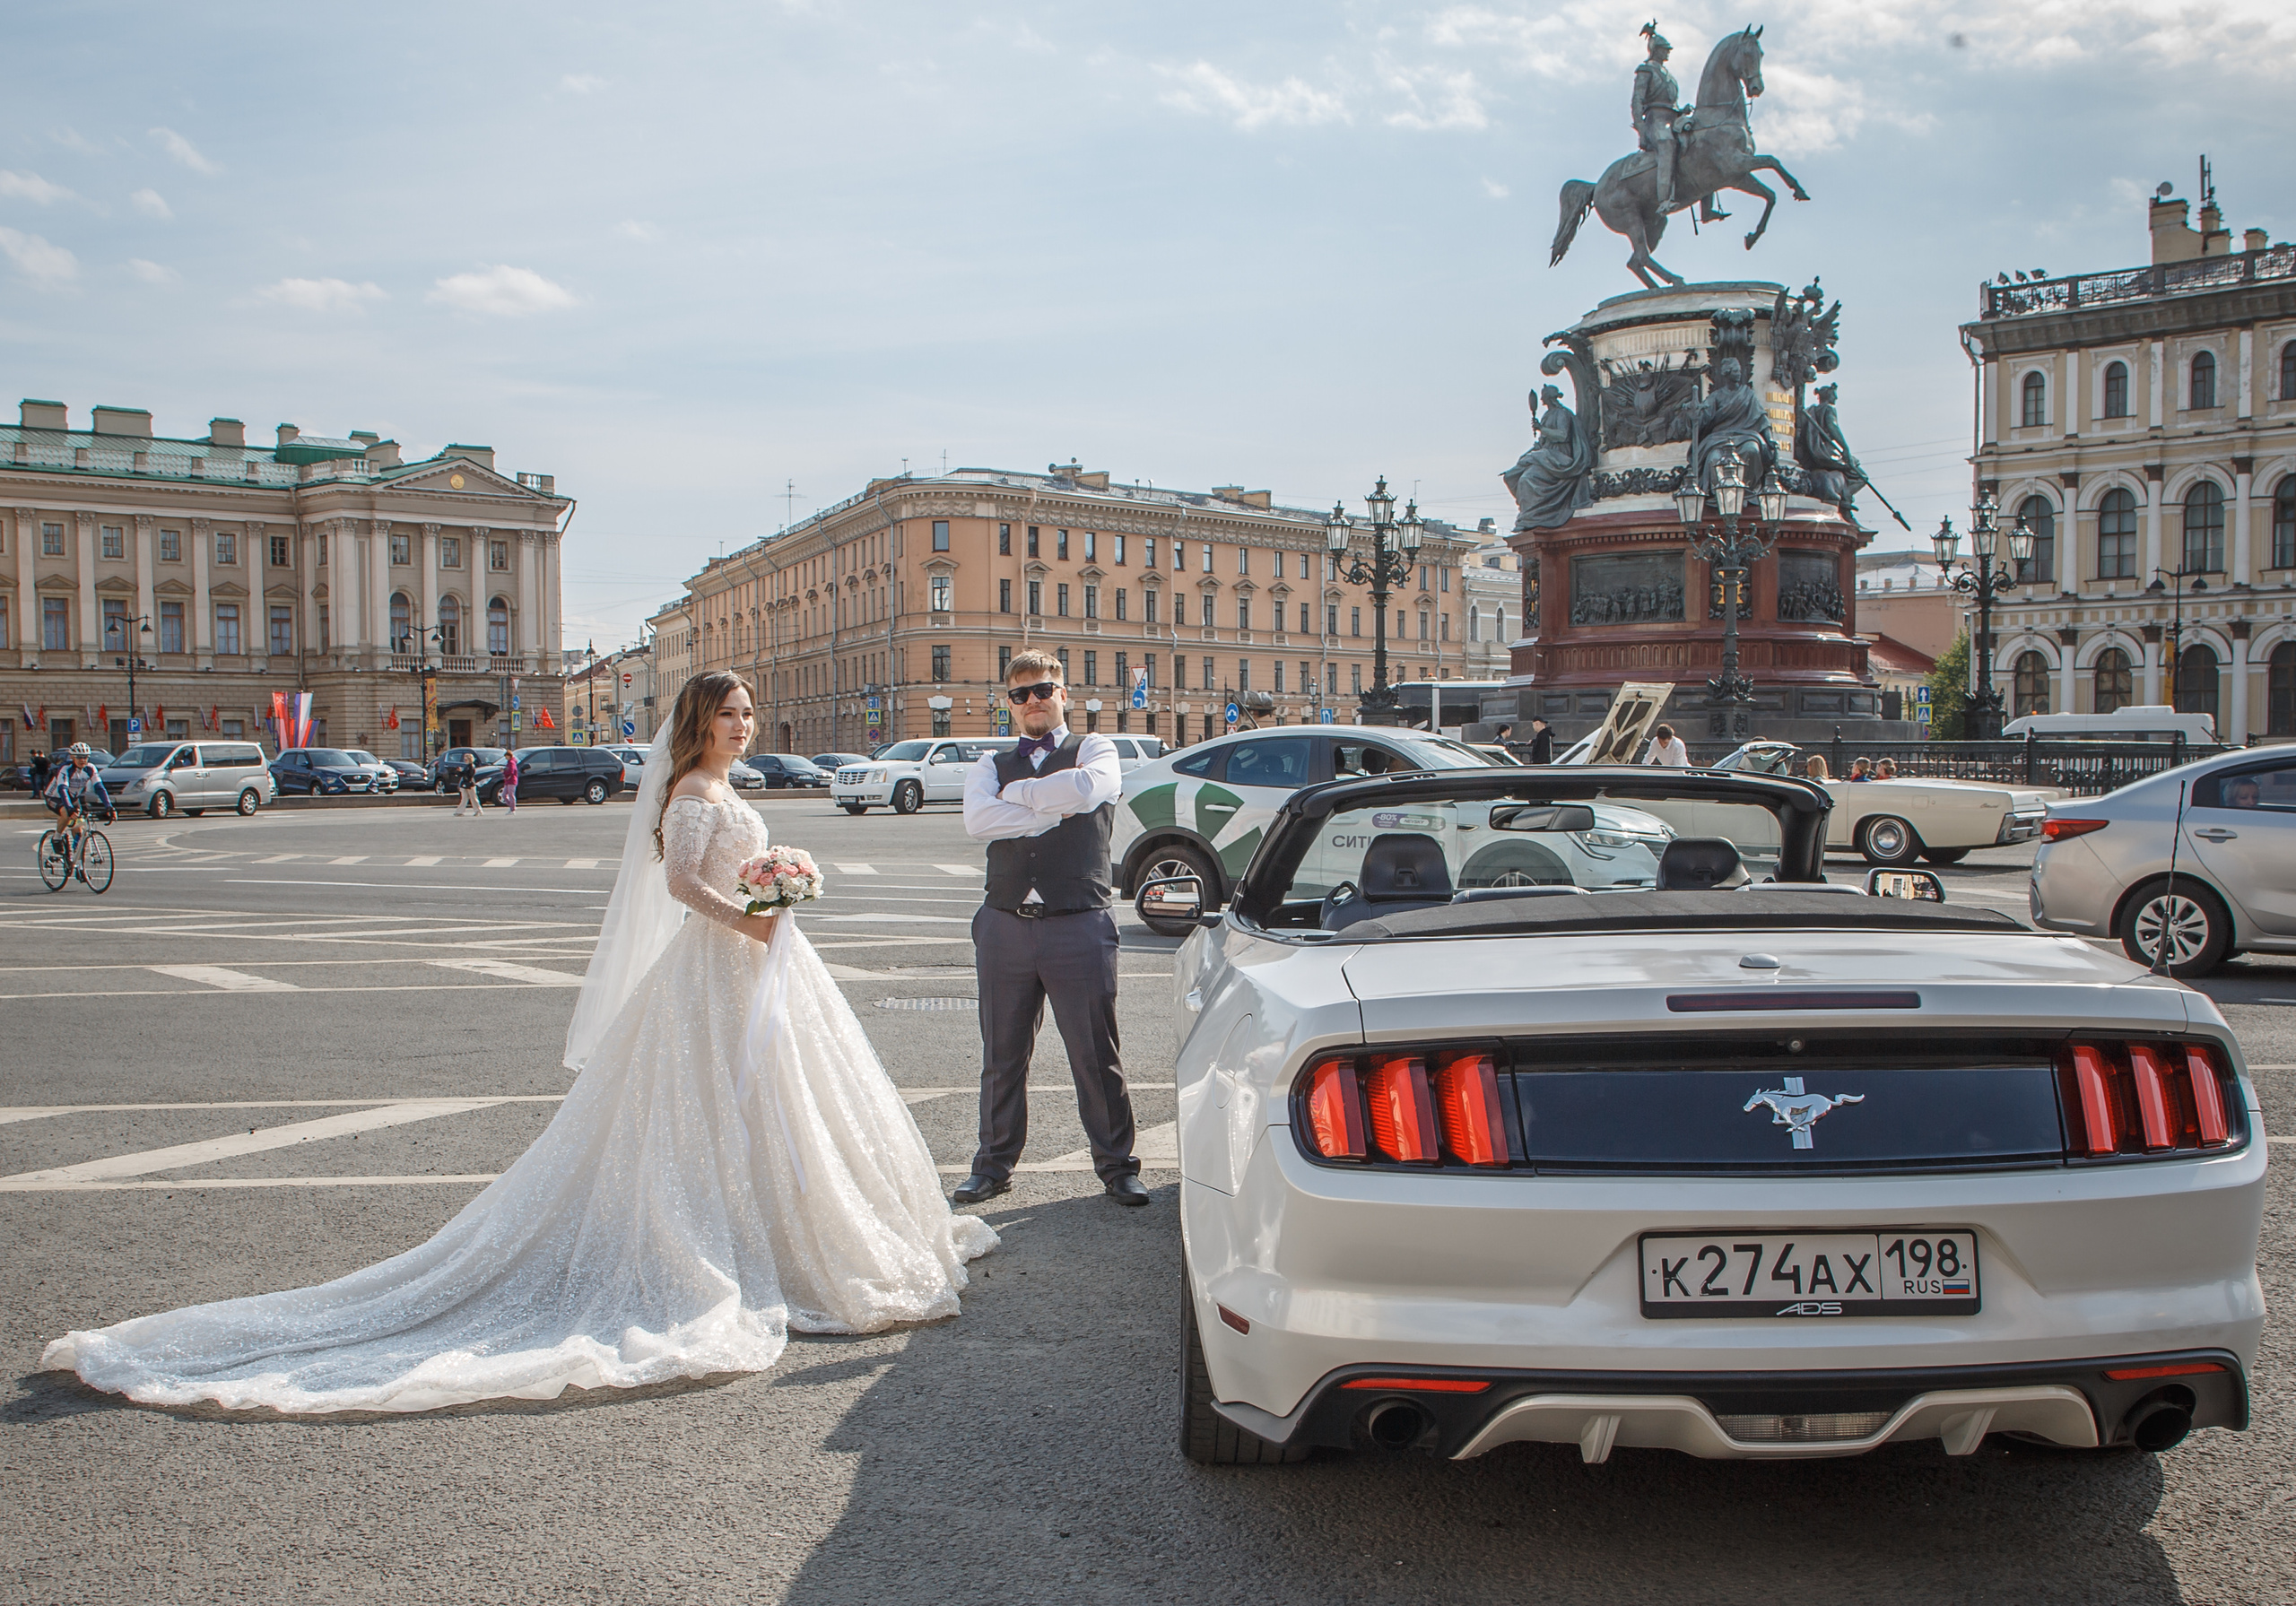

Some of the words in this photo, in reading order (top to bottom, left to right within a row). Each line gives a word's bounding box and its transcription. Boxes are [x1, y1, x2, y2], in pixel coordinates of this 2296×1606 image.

[130, 719, 139, 731] P
[1884, 1238, 1961, 1279] 198
[1903, 1280, 1942, 1295] RUS
[1776, 1301, 1843, 1316] ADS
